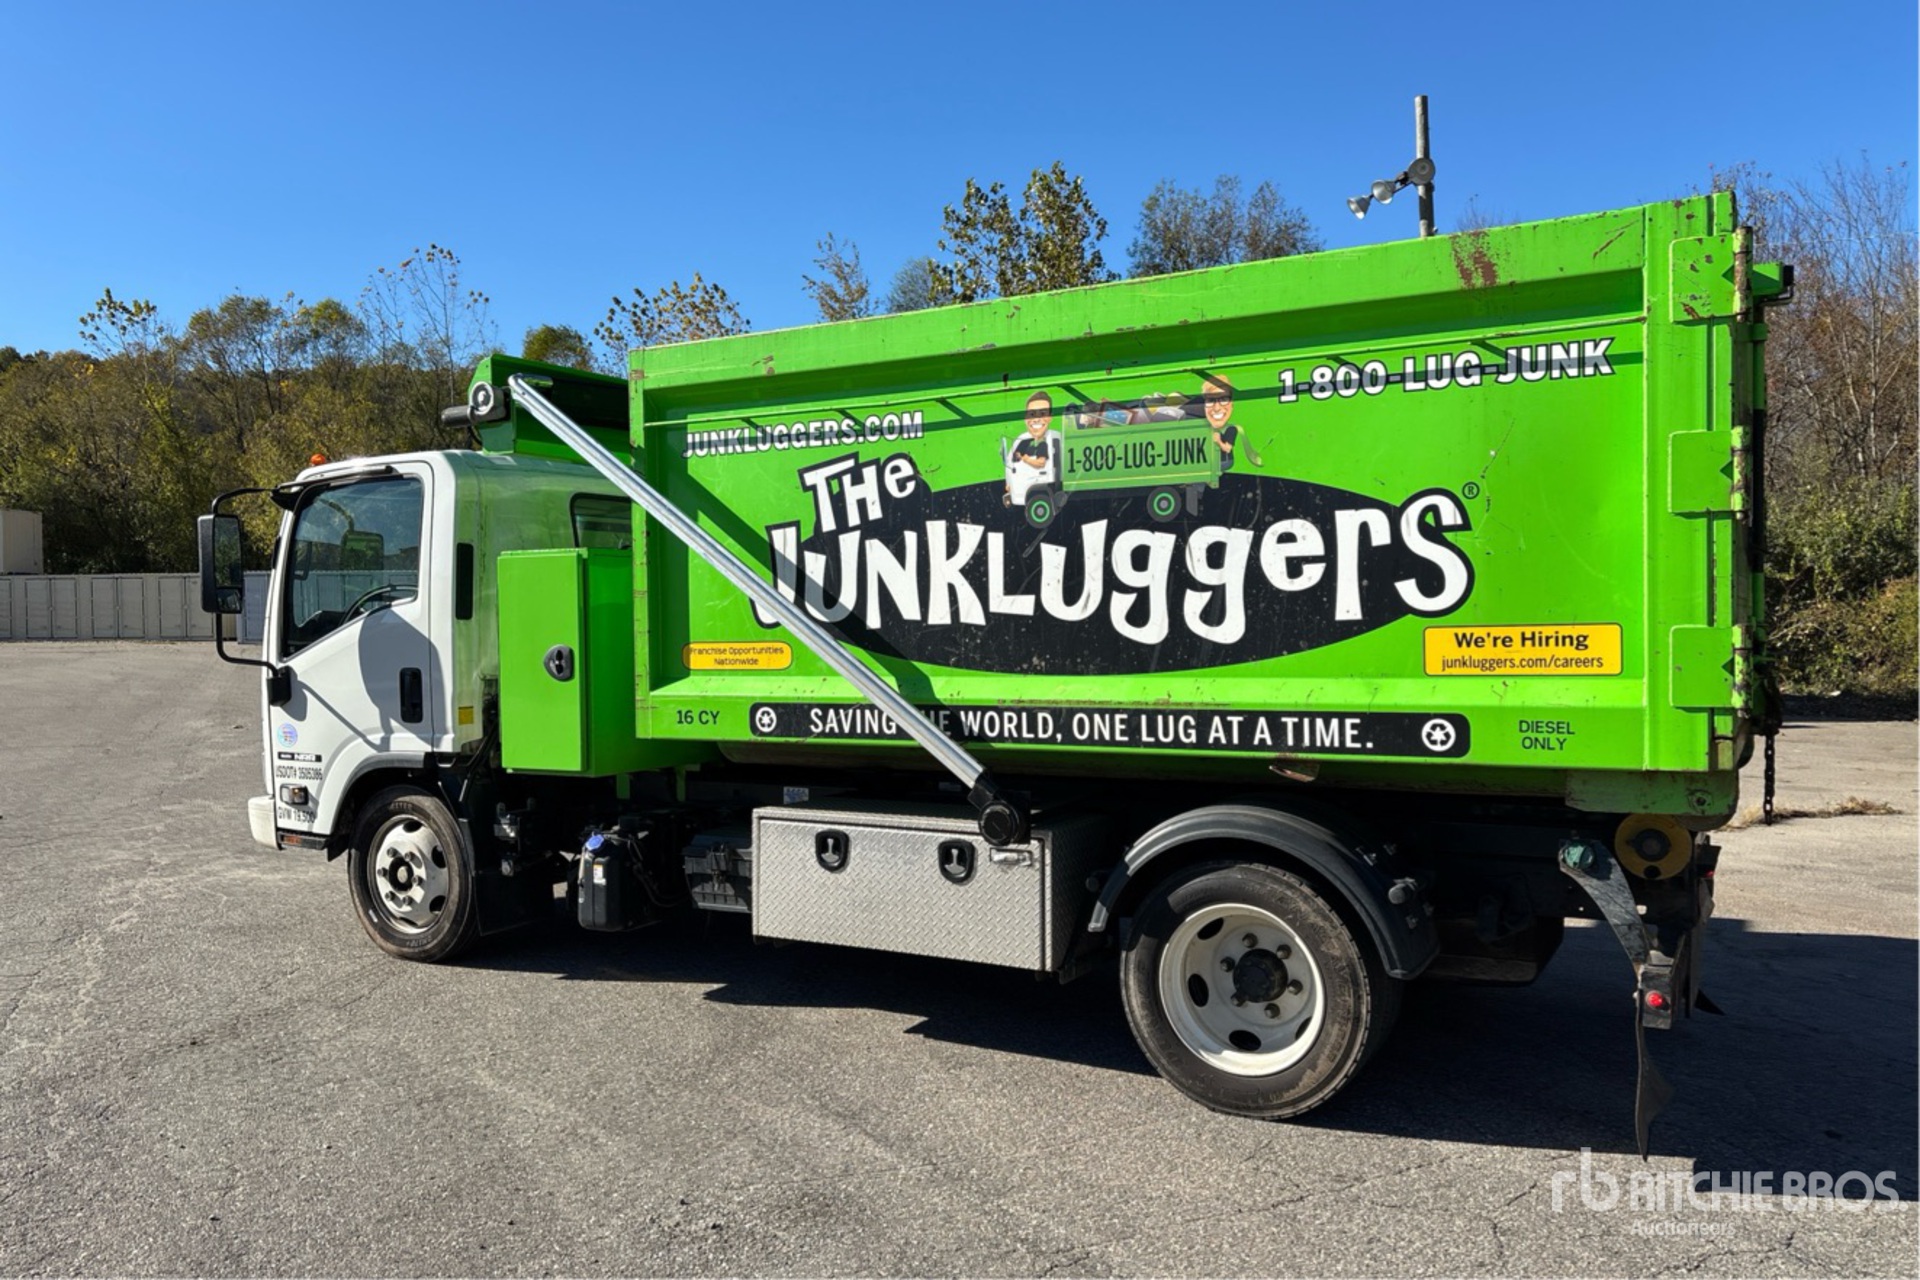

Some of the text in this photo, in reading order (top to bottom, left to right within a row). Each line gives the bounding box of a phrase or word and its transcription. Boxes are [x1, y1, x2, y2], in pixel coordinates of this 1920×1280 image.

[1279, 338, 1615, 404] 1-800-LUG-JUNK
[682, 410, 924, 458] JUNKLUGGERS.COM
[1067, 436, 1207, 473] 1-800-LUG-JUNK
[1454, 631, 1589, 650] We're Hiring
[729, 646, 784, 656] Opportunities
[714, 658, 759, 666] Nationwide
[1441, 655, 1604, 672] junkluggers.com/careers
[676, 710, 720, 725] 16 CY
[809, 708, 896, 734] SAVING
[960, 710, 1062, 742] WORLD,
[1072, 713, 1129, 741] ONE
[1141, 714, 1197, 744] LUG
[1208, 716, 1245, 745] AT
[1253, 717, 1273, 746] A
[1281, 717, 1374, 748] TIME.
[1518, 720, 1575, 734] DIESEL
[1522, 737, 1567, 750] ONLY
